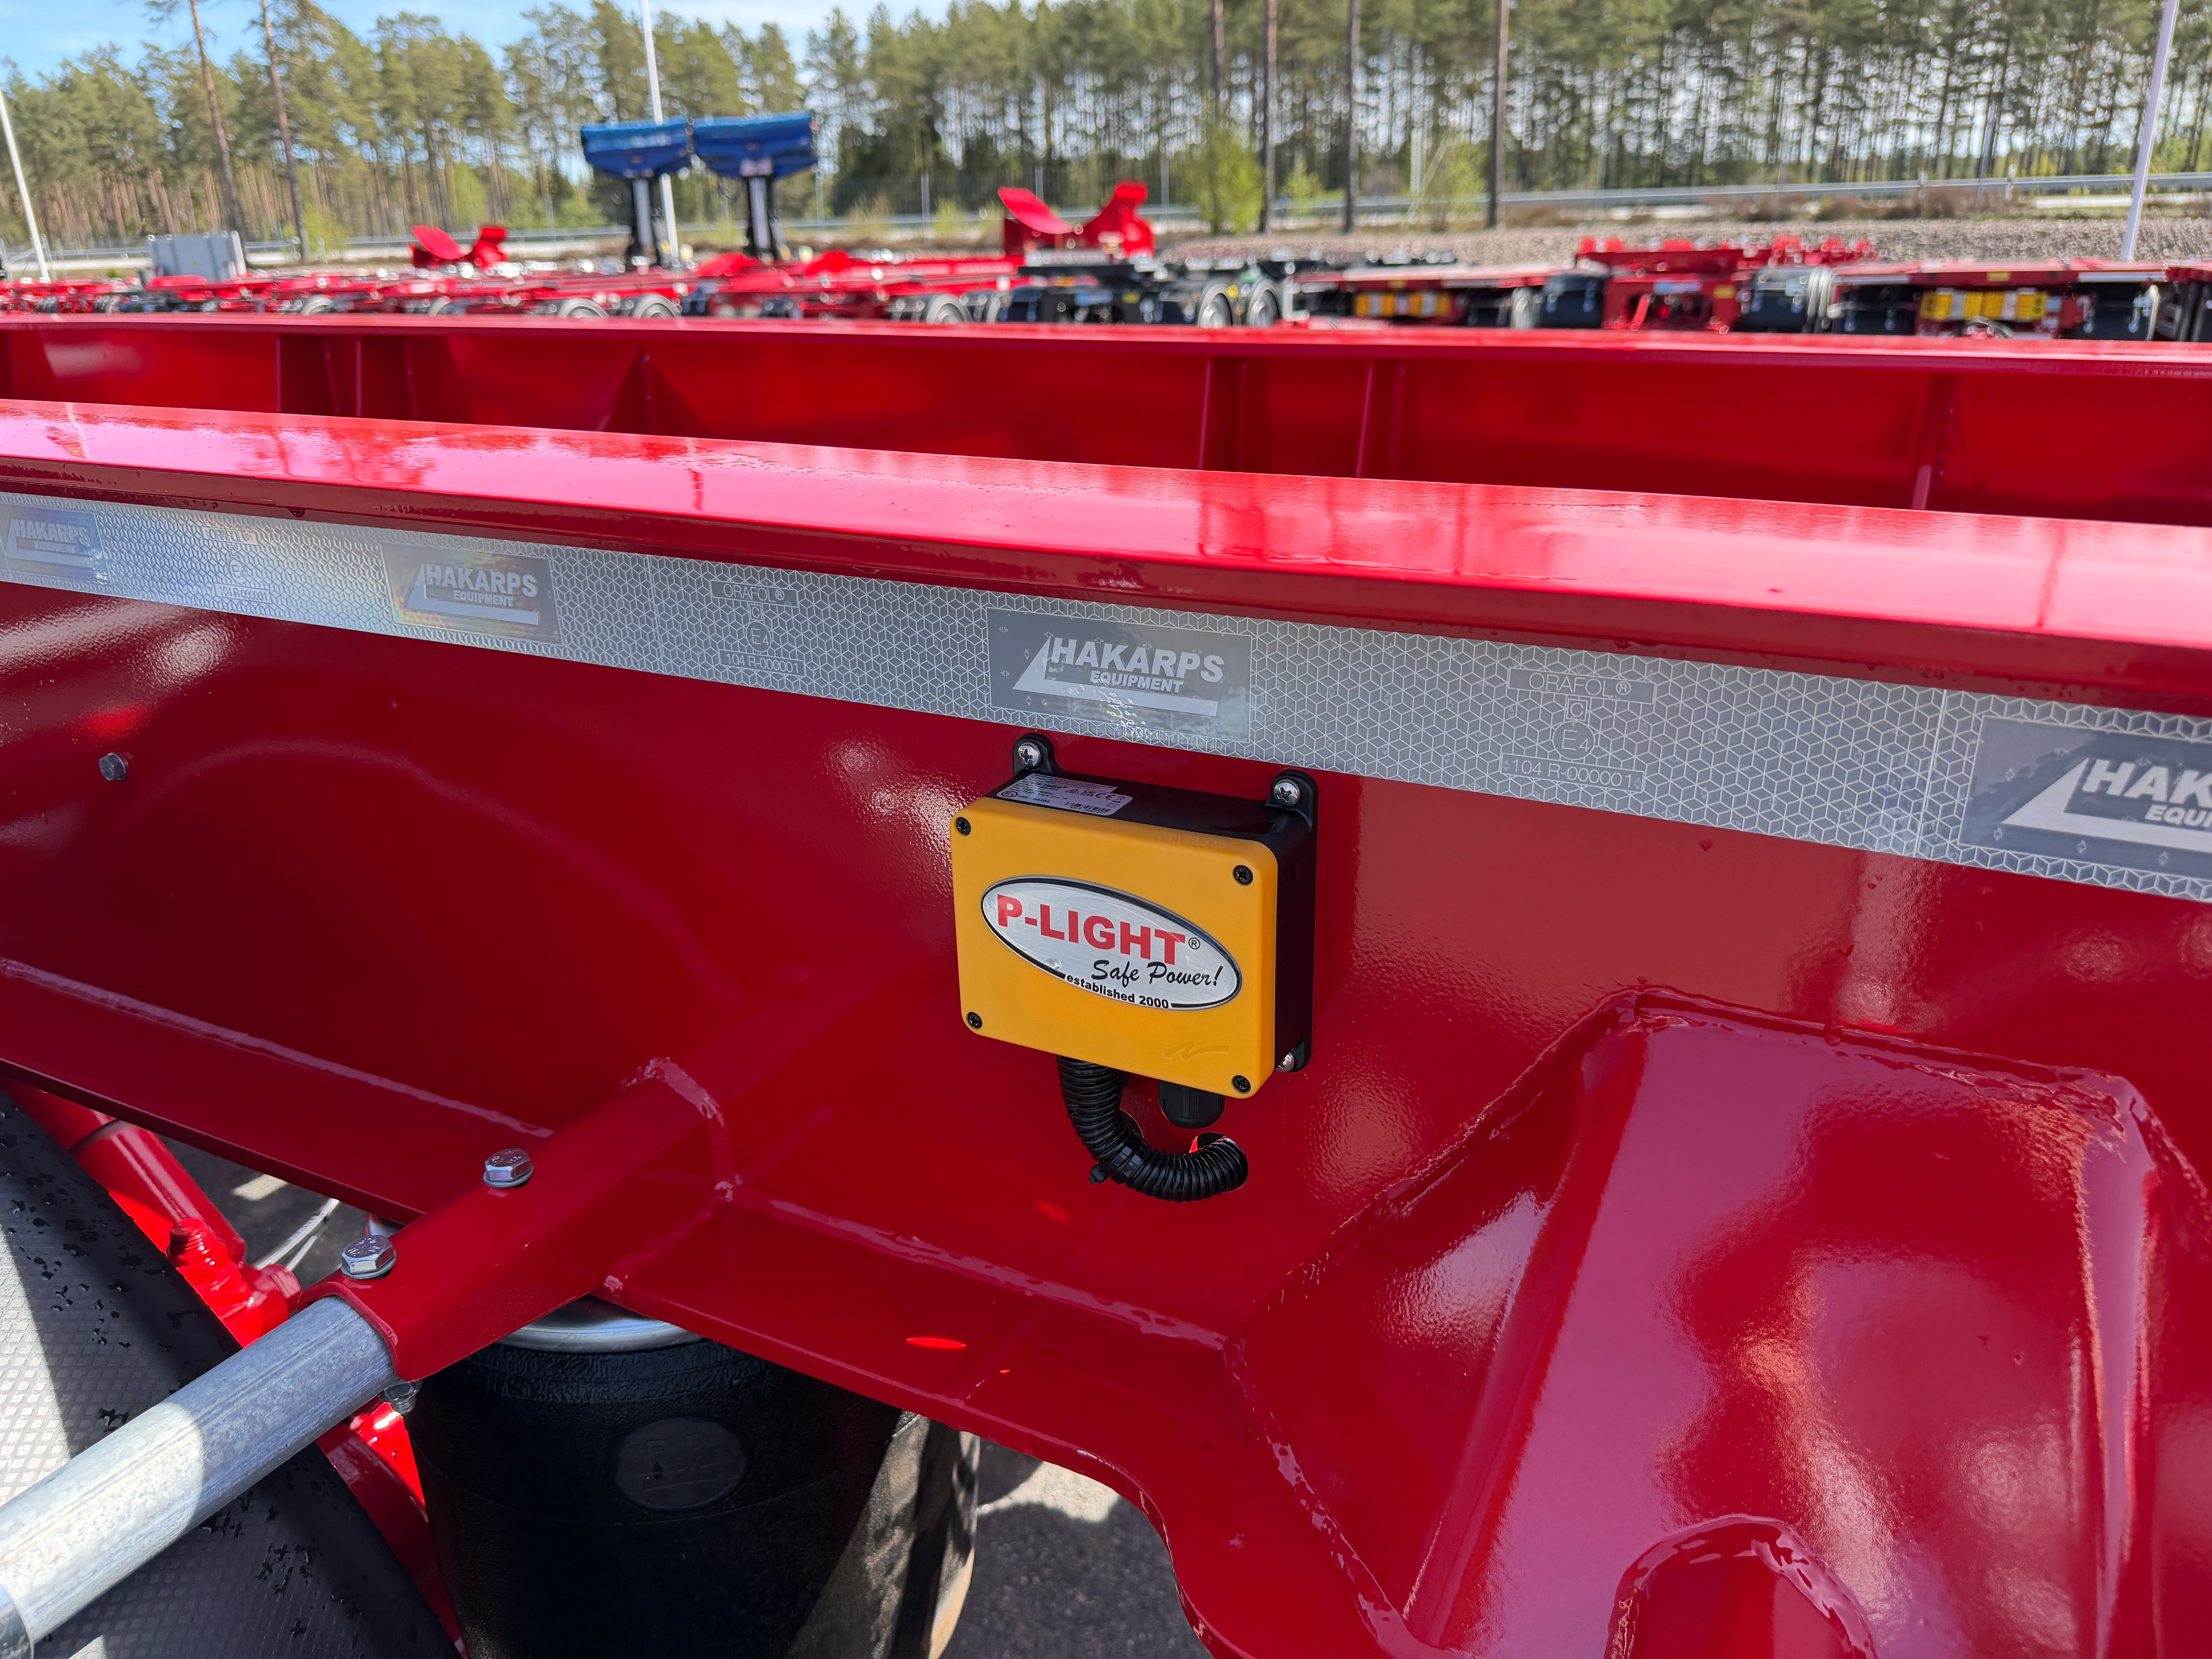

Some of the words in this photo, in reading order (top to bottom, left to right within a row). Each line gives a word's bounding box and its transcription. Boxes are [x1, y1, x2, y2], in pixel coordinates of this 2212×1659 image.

[14, 519, 91, 547] HAKARPS
[426, 564, 539, 598] HAKARPS
[453, 590, 514, 607] EQUIPMENT
[751, 606, 760, 618] C
[751, 628, 769, 646] E4
[726, 653, 745, 666] 104
[748, 655, 799, 674] R-000001
[1051, 637, 1224, 683] HAKARPS
[1089, 670, 1184, 693] EQUIPMENT
[1570, 702, 1584, 717] C
[1561, 729, 1590, 752] E4
[1512, 758, 1542, 776] 104
[1548, 763, 1631, 788] R-000001
[2081, 759, 2212, 809] HAK
[1091, 959, 1140, 988] Safe
[1146, 961, 1224, 986] Power!
[1066, 974, 1135, 1003] established
[1139, 995, 1169, 1008] 2000
